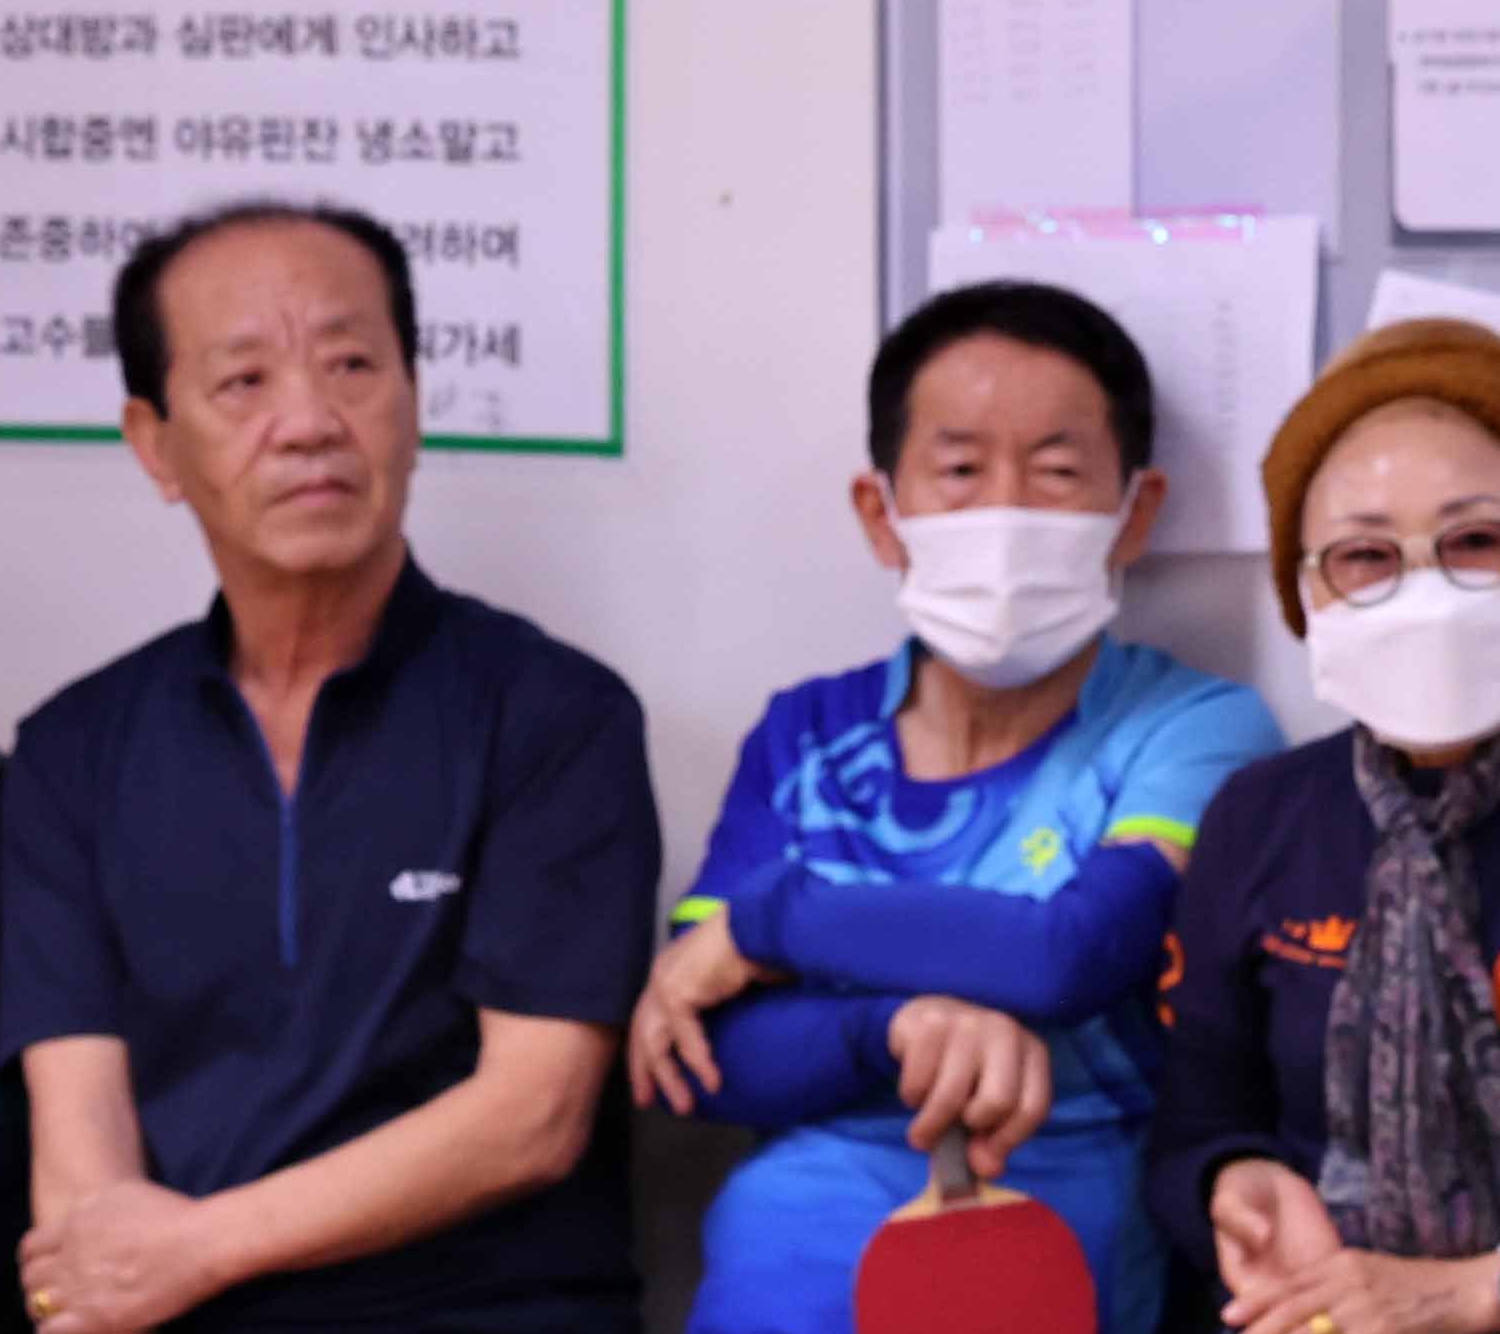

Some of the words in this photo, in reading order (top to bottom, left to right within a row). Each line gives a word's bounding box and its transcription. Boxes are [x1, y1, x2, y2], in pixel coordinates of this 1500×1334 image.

[176, 13, 340, 59] 심판에게
[353, 14, 521, 61] 인사하고
[173, 115, 340, 163] 야유핀잔
[356, 119, 519, 166] 냉소말고
